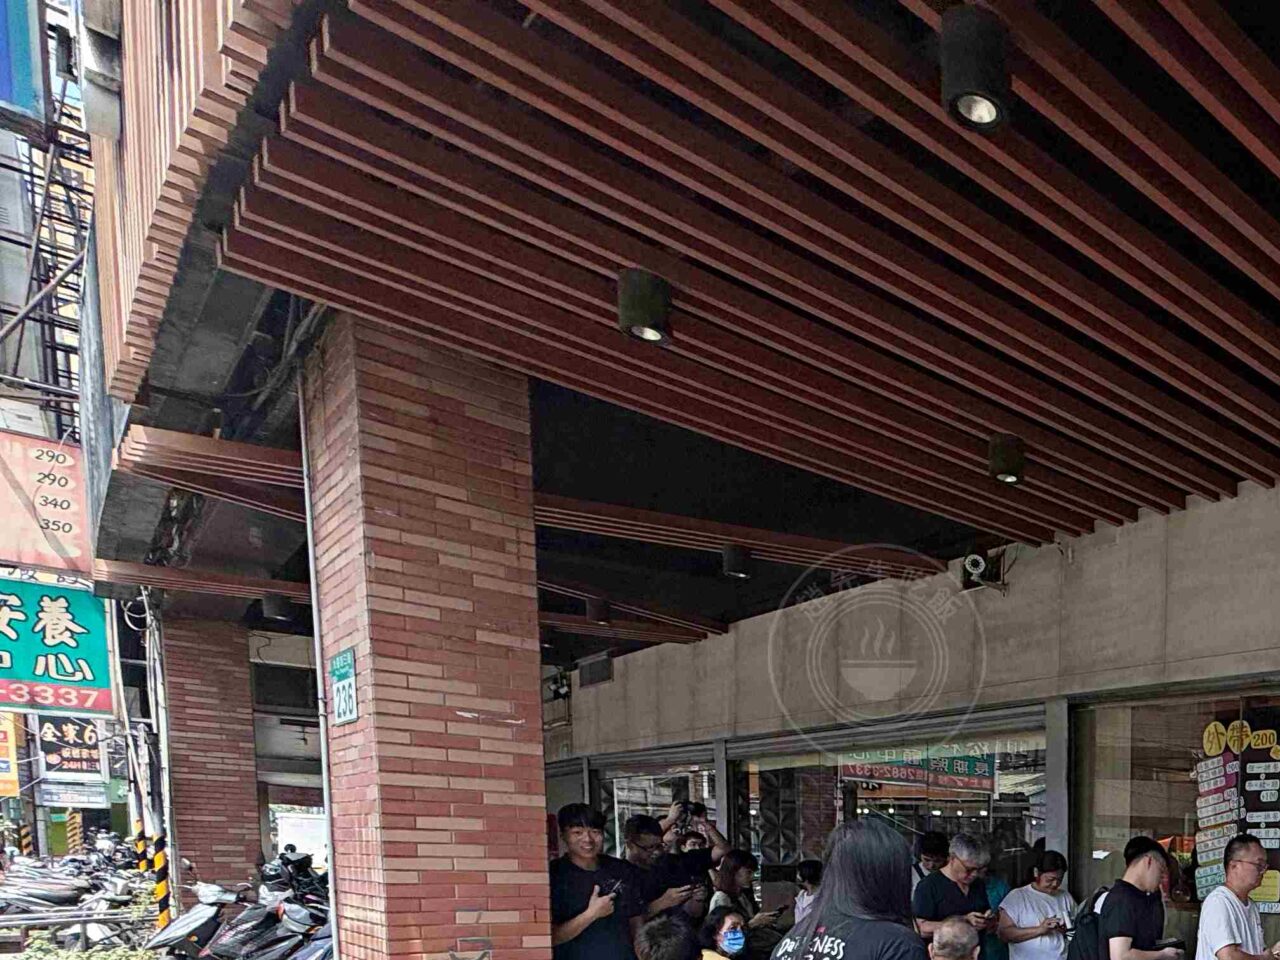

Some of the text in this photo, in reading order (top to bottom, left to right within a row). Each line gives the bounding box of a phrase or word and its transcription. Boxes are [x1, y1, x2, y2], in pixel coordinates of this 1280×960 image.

[35, 448, 67, 464] 290
[36, 472, 69, 488] 290
[39, 495, 71, 510] 340
[40, 518, 73, 533] 350
[335, 681, 354, 719] 236
[1204, 722, 1276, 754] 外帶 200
